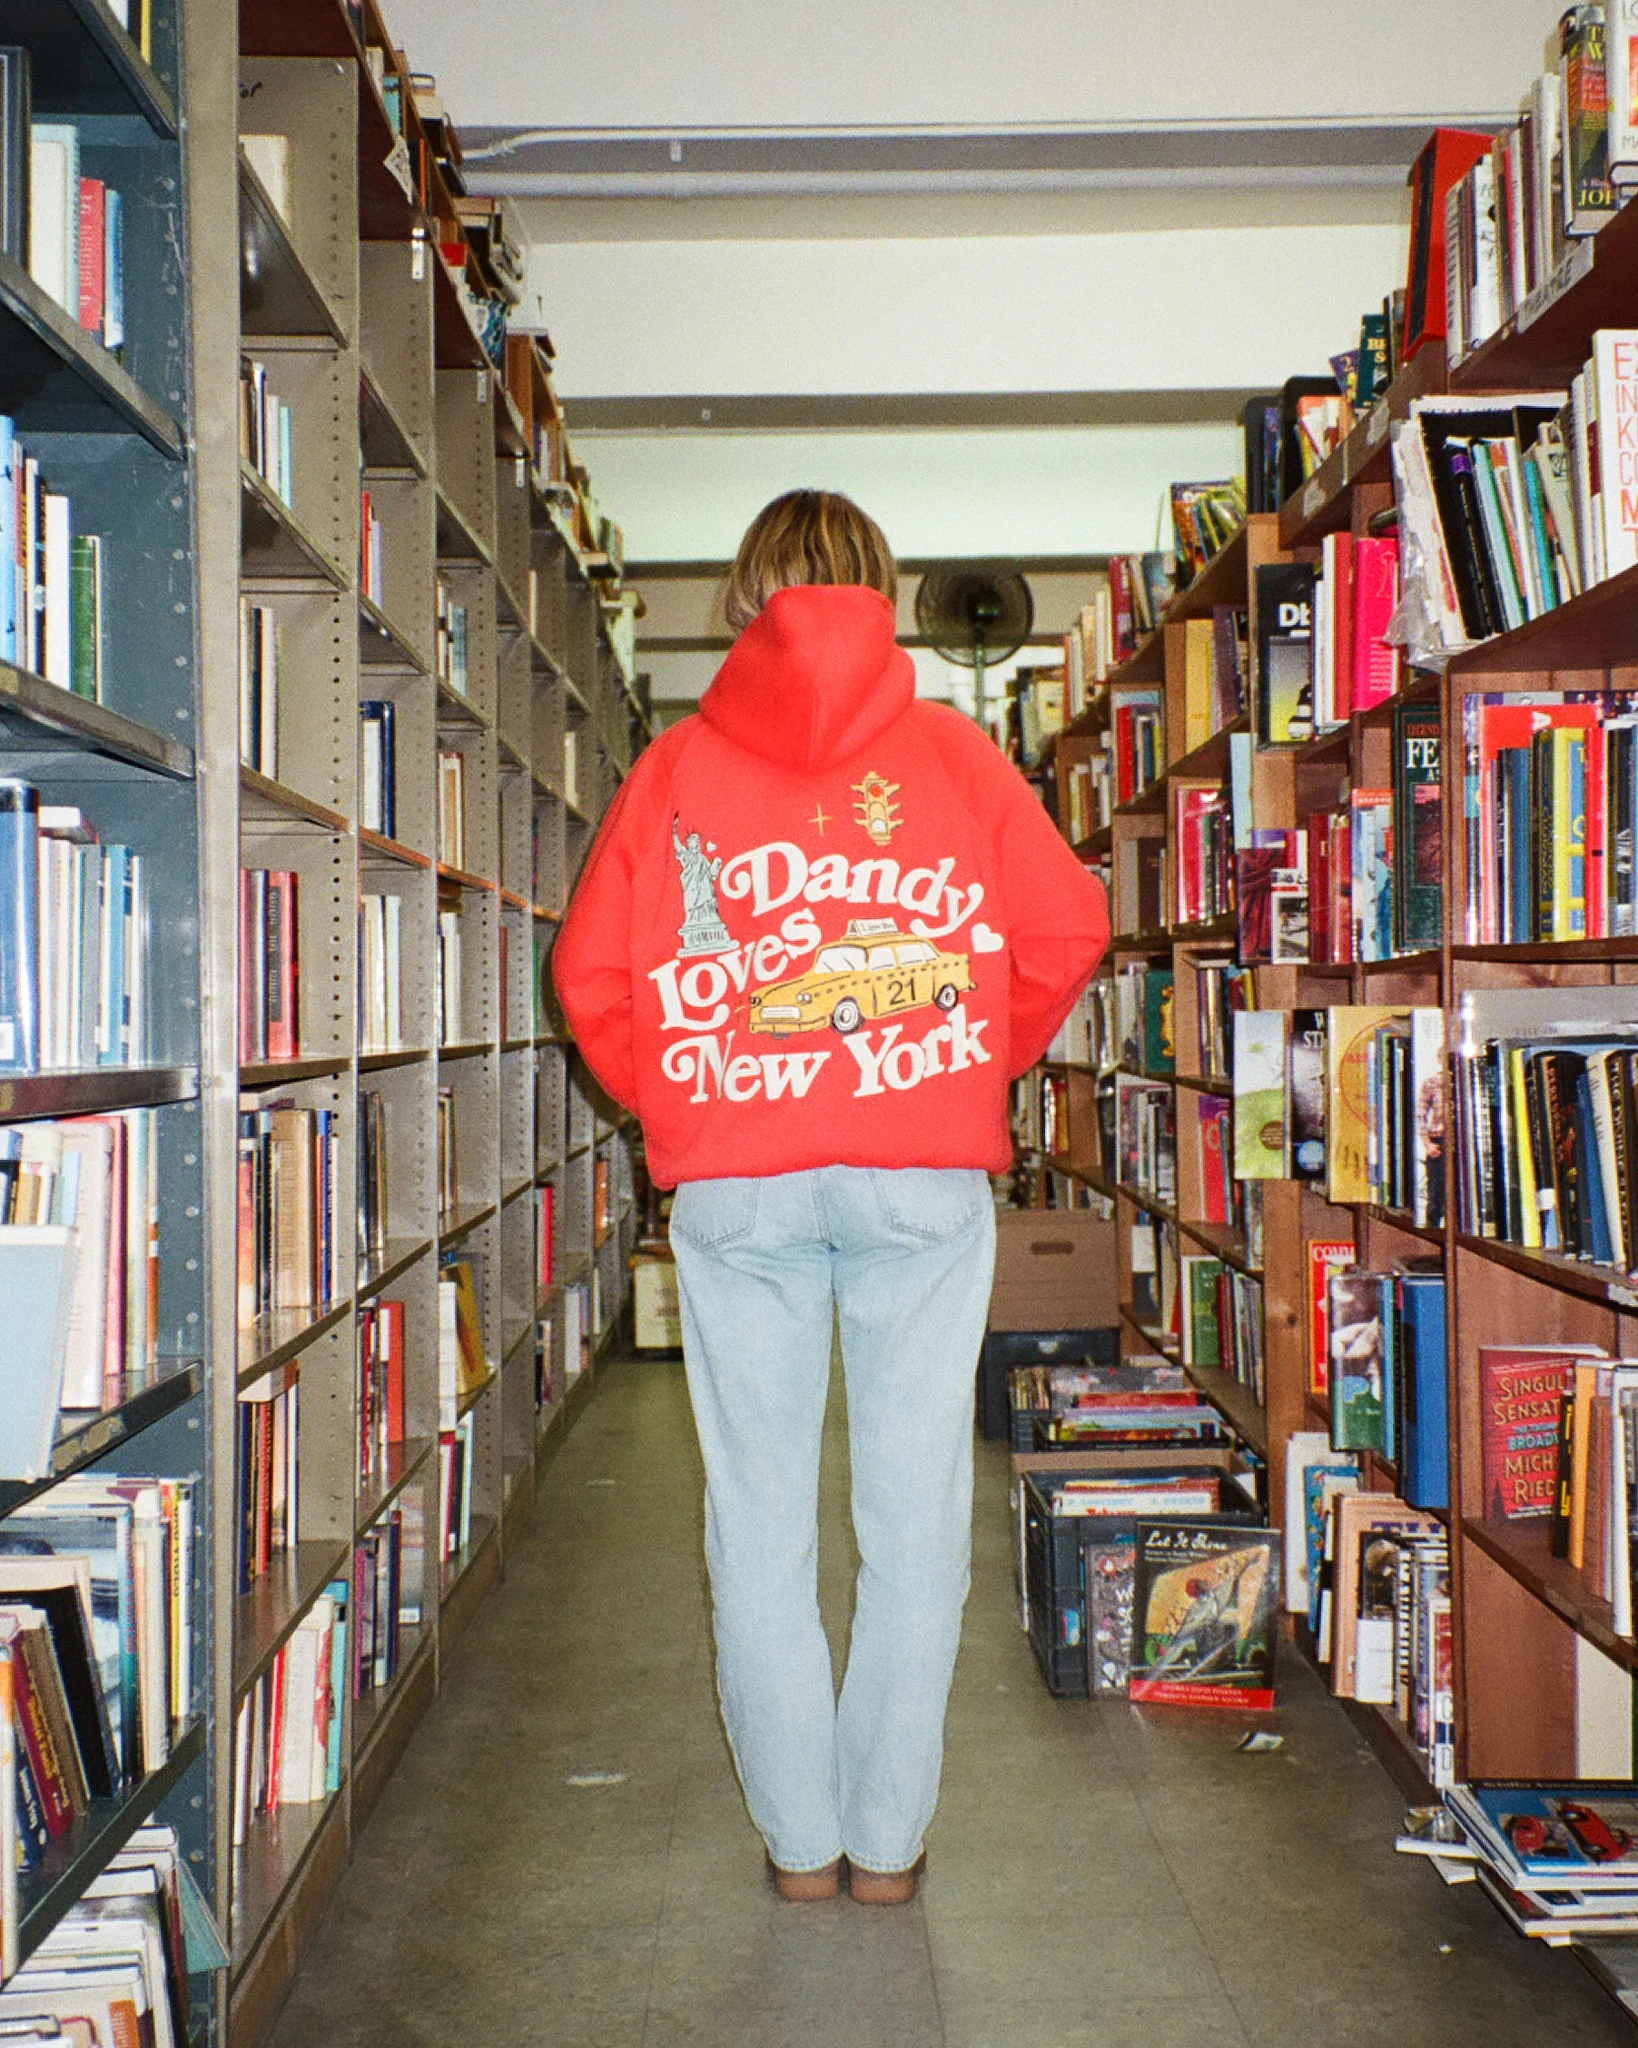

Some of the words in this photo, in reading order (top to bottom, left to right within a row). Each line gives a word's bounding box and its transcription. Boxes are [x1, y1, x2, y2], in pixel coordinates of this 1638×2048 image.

[720, 841, 984, 938] Dandy
[648, 907, 822, 1032] Loves
[887, 977, 916, 1006] 21
[661, 1030, 832, 1104] New
[842, 1002, 992, 1098] York
